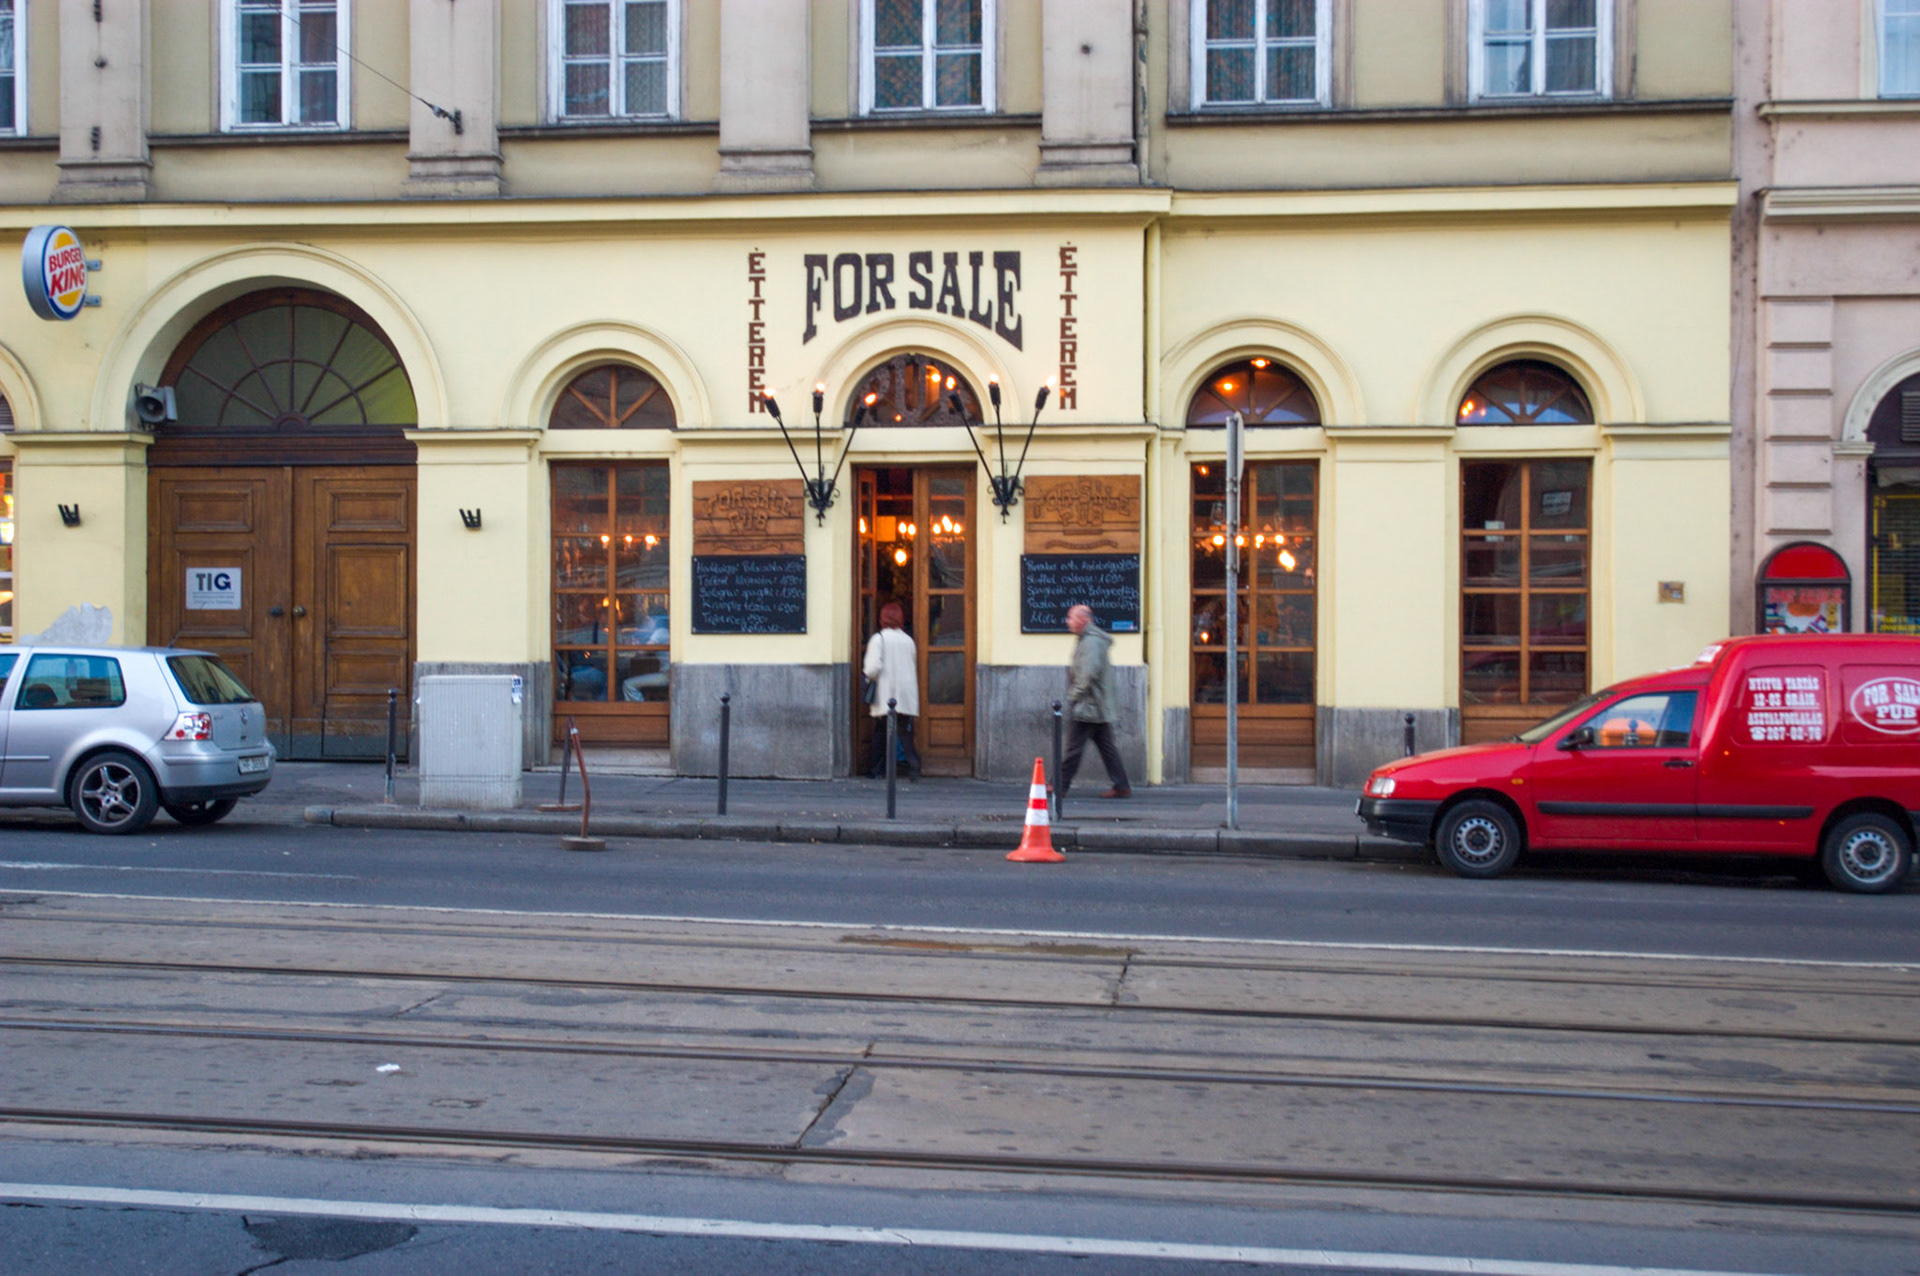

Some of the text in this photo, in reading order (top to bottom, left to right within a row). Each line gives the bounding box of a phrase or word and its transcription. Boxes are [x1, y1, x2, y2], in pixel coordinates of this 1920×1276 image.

[49, 247, 82, 273] BURGER
[49, 263, 85, 298] KING
[802, 250, 1023, 353] FOR SALE
[195, 572, 232, 591] TIG
[1863, 683, 1890, 707] FOR
[1876, 704, 1917, 719] PUB
